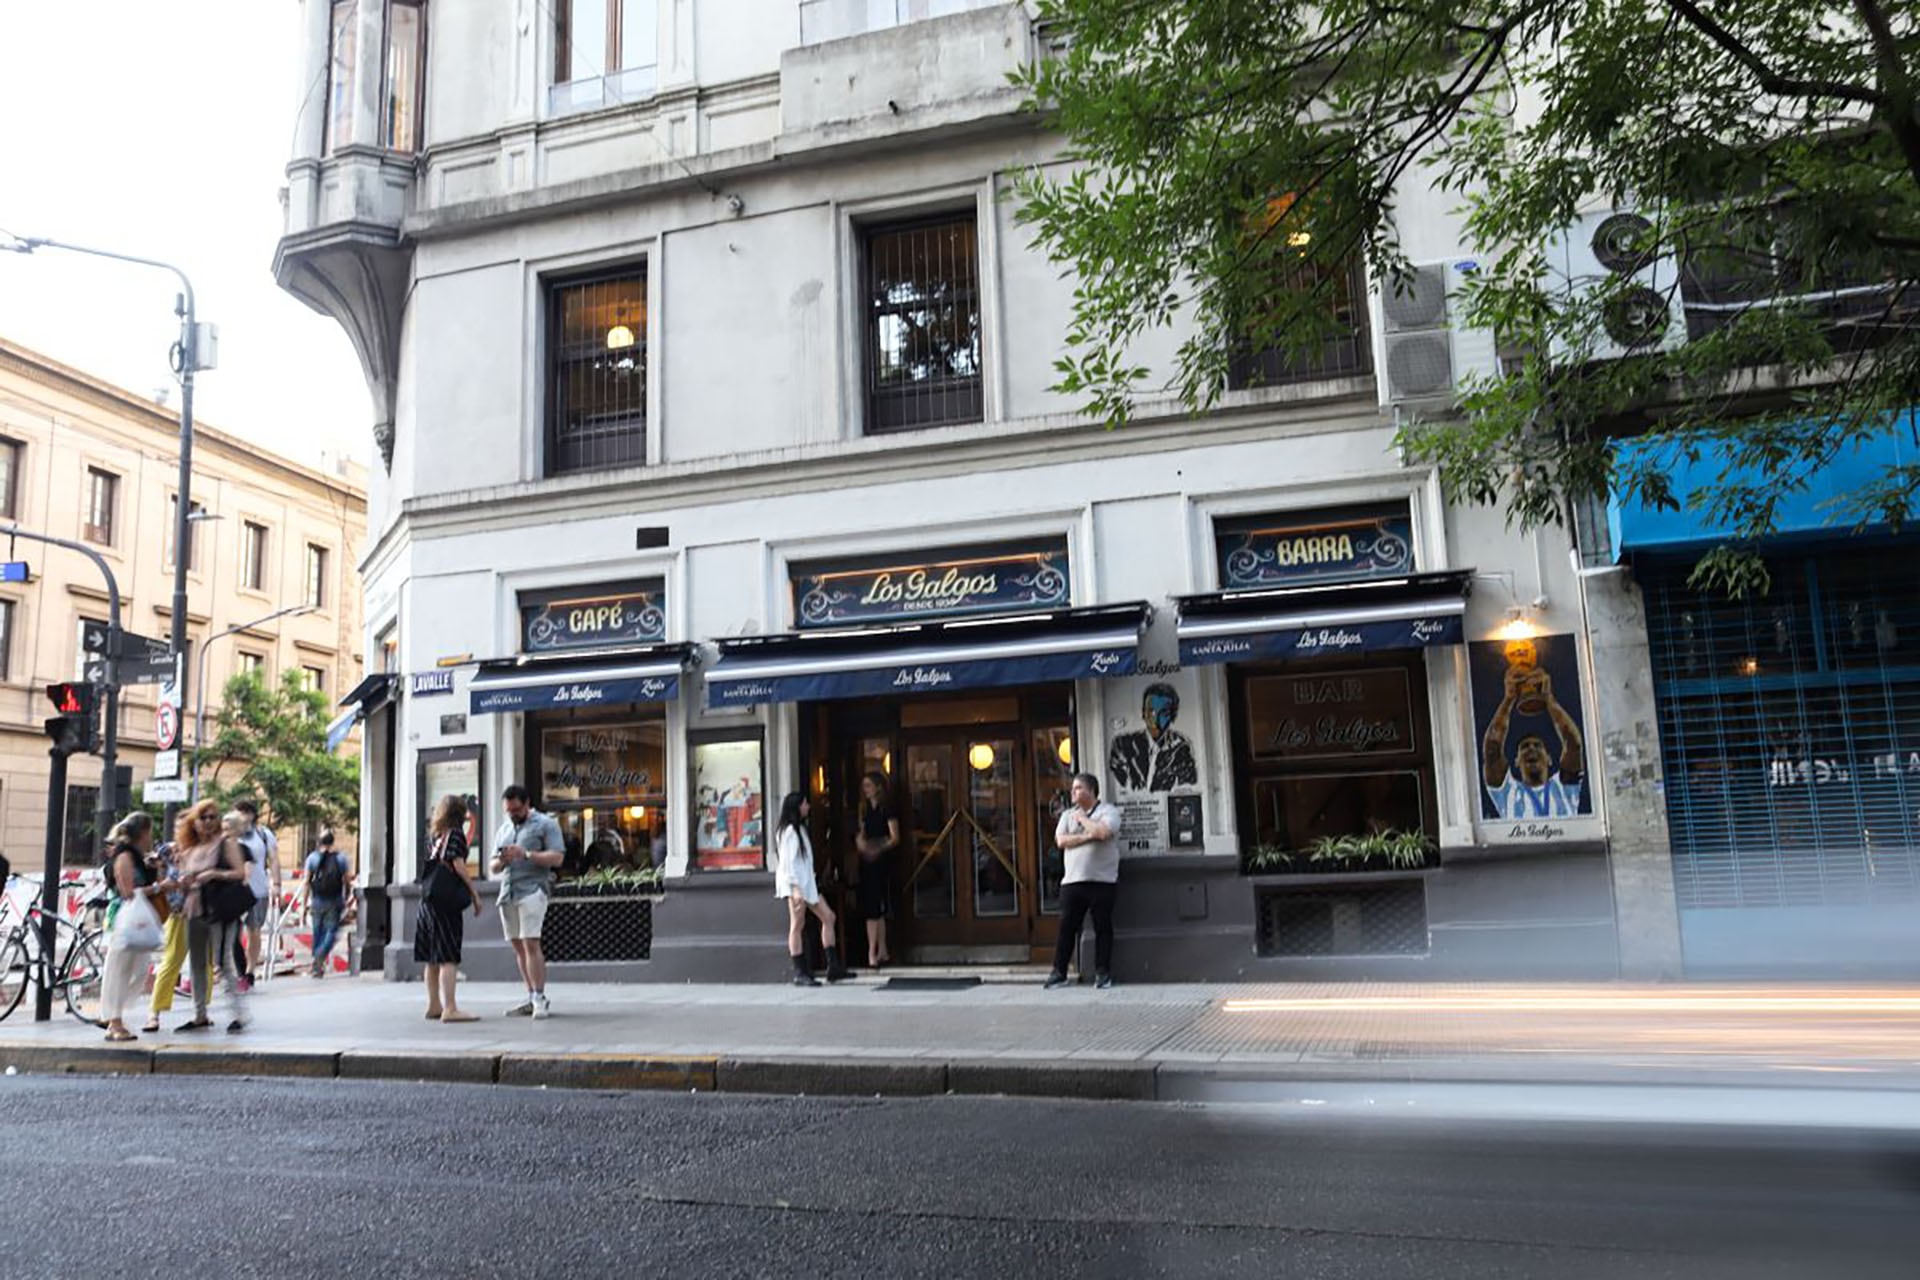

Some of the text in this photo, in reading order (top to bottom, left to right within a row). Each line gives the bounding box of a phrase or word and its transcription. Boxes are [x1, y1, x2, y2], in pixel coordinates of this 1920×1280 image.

[1277, 534, 1354, 566] BARRA
[861, 567, 998, 606] Los Galgos
[1296, 629, 1363, 649] Los Galgos
[414, 673, 450, 693] LAVALLE
[893, 667, 952, 686] Los Galgos
[553, 683, 602, 702] Los Galgos
[1293, 678, 1364, 705] BAR
[576, 729, 629, 753] BAR
[1271, 713, 1400, 751] Los Galgos
[1508, 823, 1565, 841] Los Galgos
